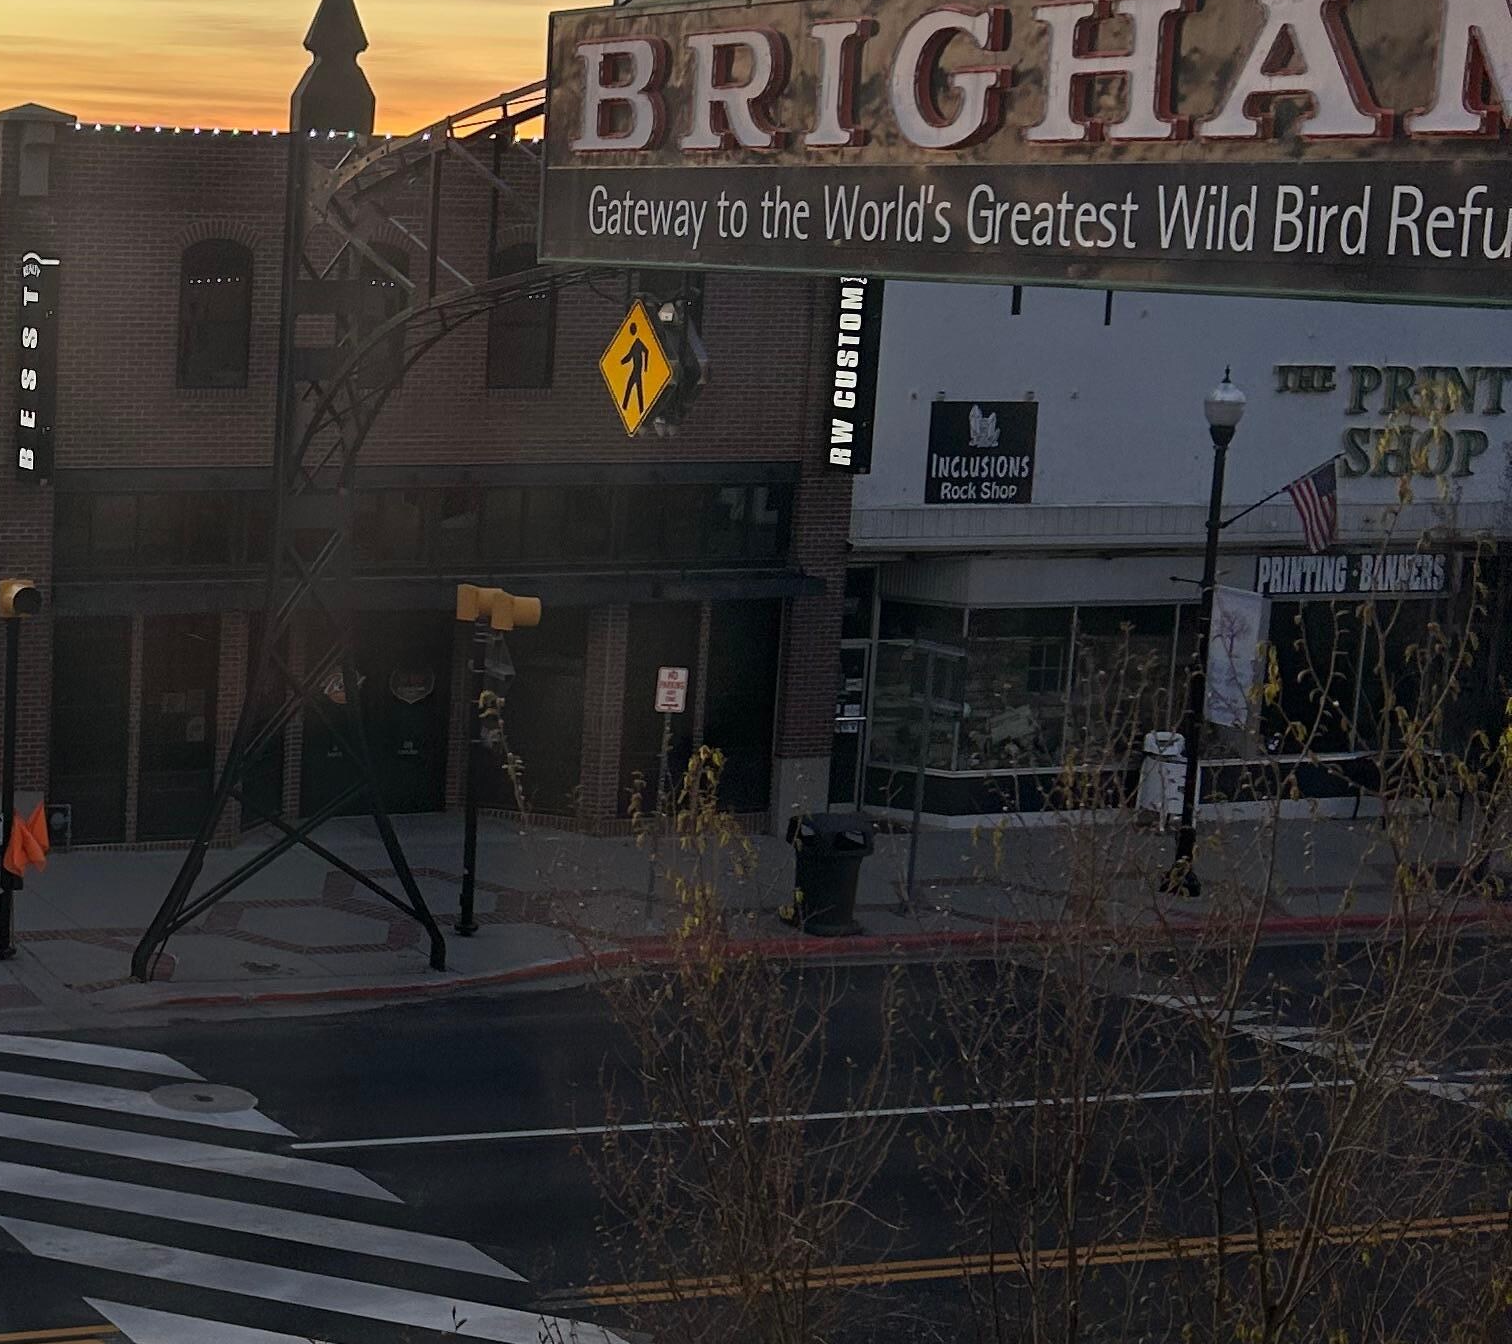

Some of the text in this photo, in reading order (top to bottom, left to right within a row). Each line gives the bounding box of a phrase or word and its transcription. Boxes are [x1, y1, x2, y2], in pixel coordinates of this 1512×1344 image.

[588, 183, 1512, 259] Gateway to the World's Greatest Wild Bird Refu
[833, 287, 865, 409] CUSTOM
[18, 285, 39, 470] BESST
[1276, 365, 1336, 394] THE
[829, 418, 854, 466] RW
[931, 452, 1030, 479] INCLUSIONS
[1339, 427, 1489, 478] SHOP
[940, 481, 1018, 500] Rock Shop
[1257, 555, 1348, 593] PRINTING
